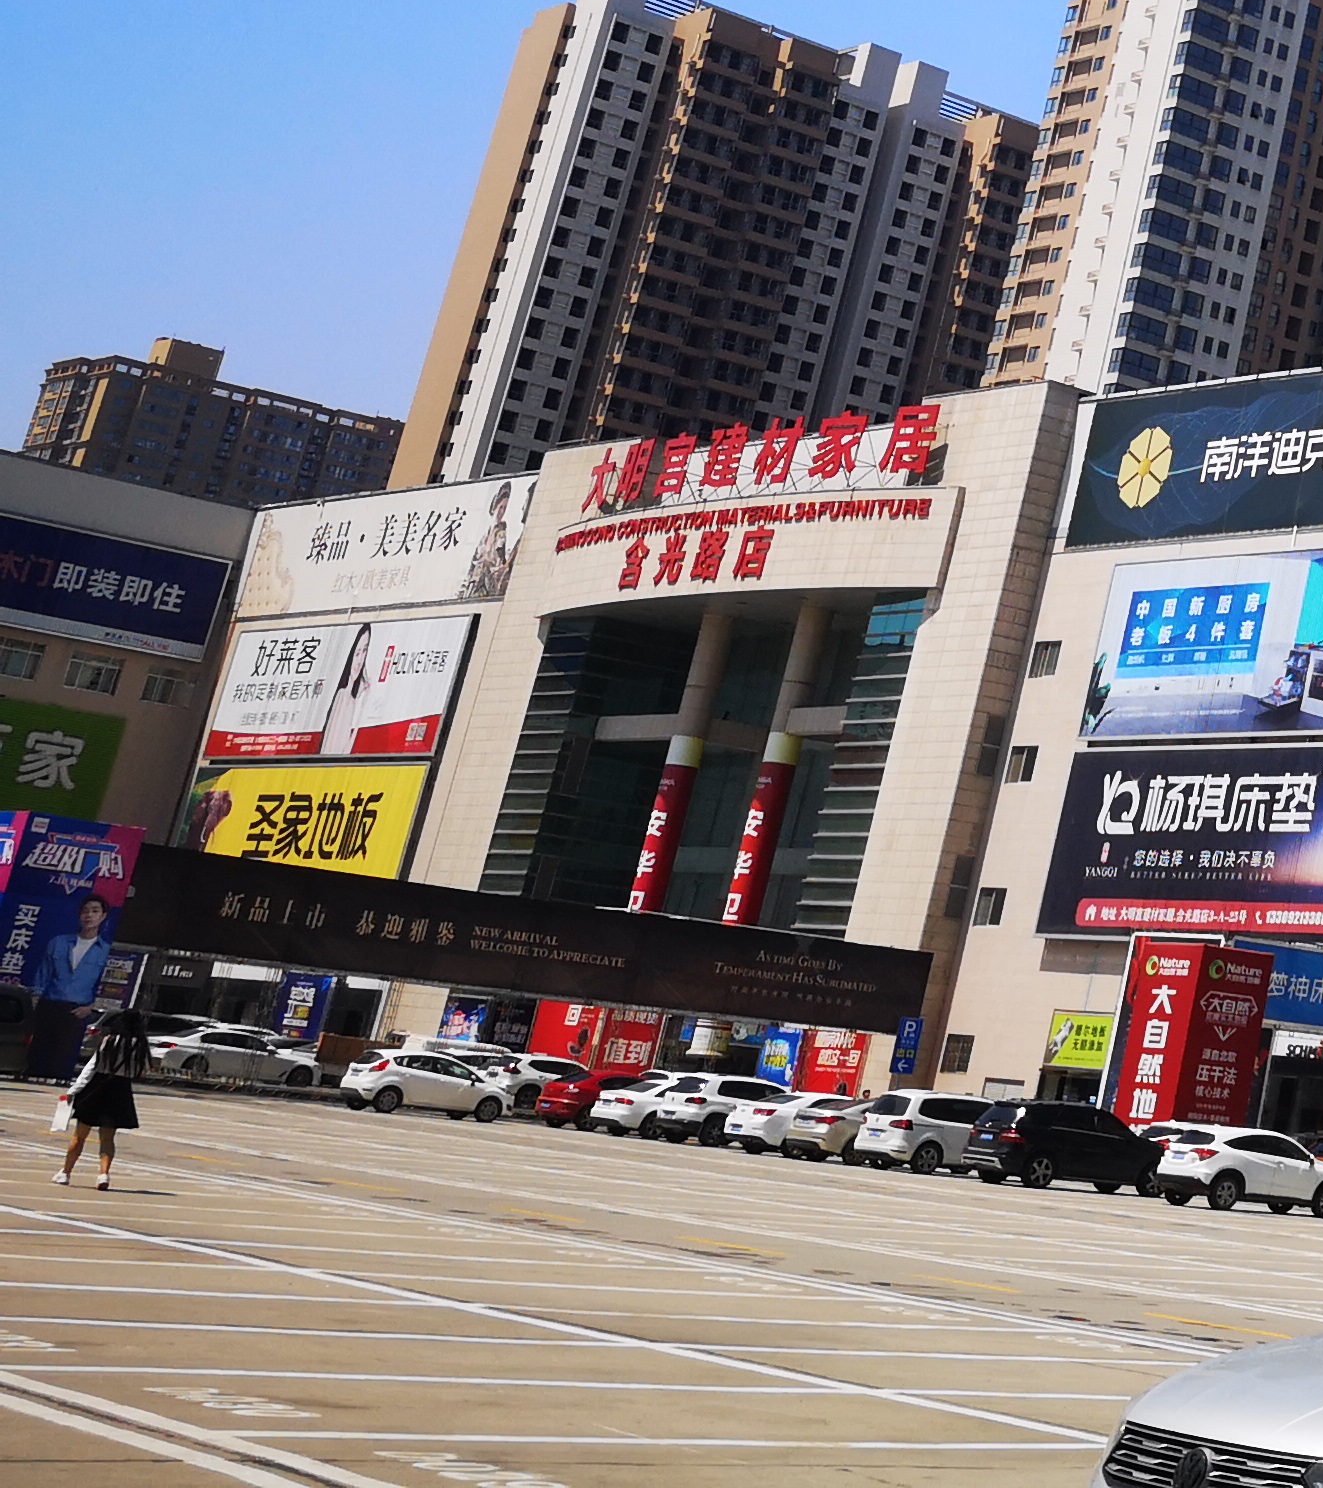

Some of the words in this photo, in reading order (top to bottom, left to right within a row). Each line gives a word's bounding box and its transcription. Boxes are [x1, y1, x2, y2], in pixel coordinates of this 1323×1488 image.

[582, 404, 941, 513] 大明宫建材家居
[617, 526, 774, 591] 含光路店
[251, 636, 321, 677] 好莱客
[1140, 772, 1317, 833] 杨琪床垫
[241, 791, 384, 862] 圣象地板
[220, 891, 327, 930] 新品上市
[356, 910, 456, 945] 恭迎雅鉴
[472, 926, 502, 939] NEW
[470, 939, 528, 956] WELCOME
[532, 947, 548, 958] TO
[550, 949, 625, 968] APPRECIATE
[1160, 957, 1190, 969] Nature
[1226, 962, 1262, 977] Nature
[904, 1021, 917, 1038] P
